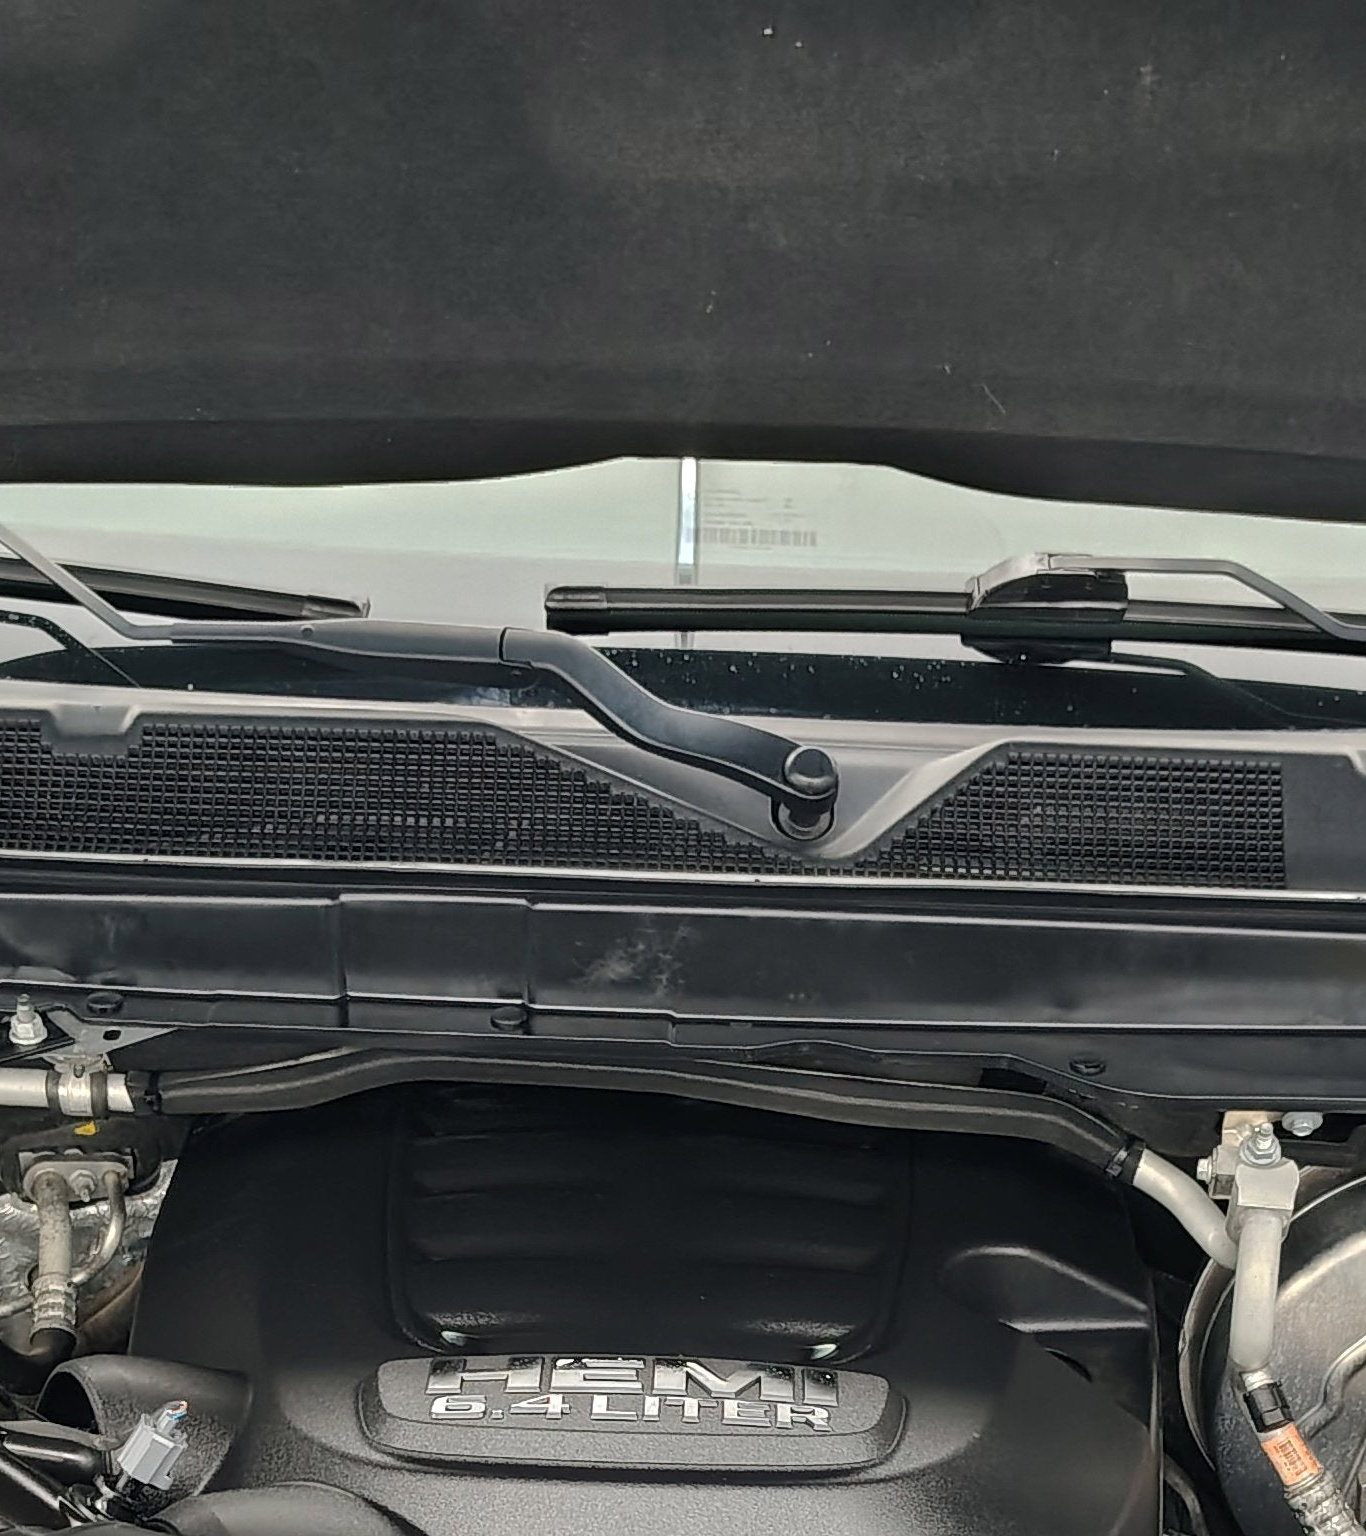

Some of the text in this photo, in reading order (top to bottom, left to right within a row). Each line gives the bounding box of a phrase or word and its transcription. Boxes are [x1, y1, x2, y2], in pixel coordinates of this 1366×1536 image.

[425, 1355, 839, 1407] HEMI
[430, 1394, 833, 1433] 6.4 LITER
